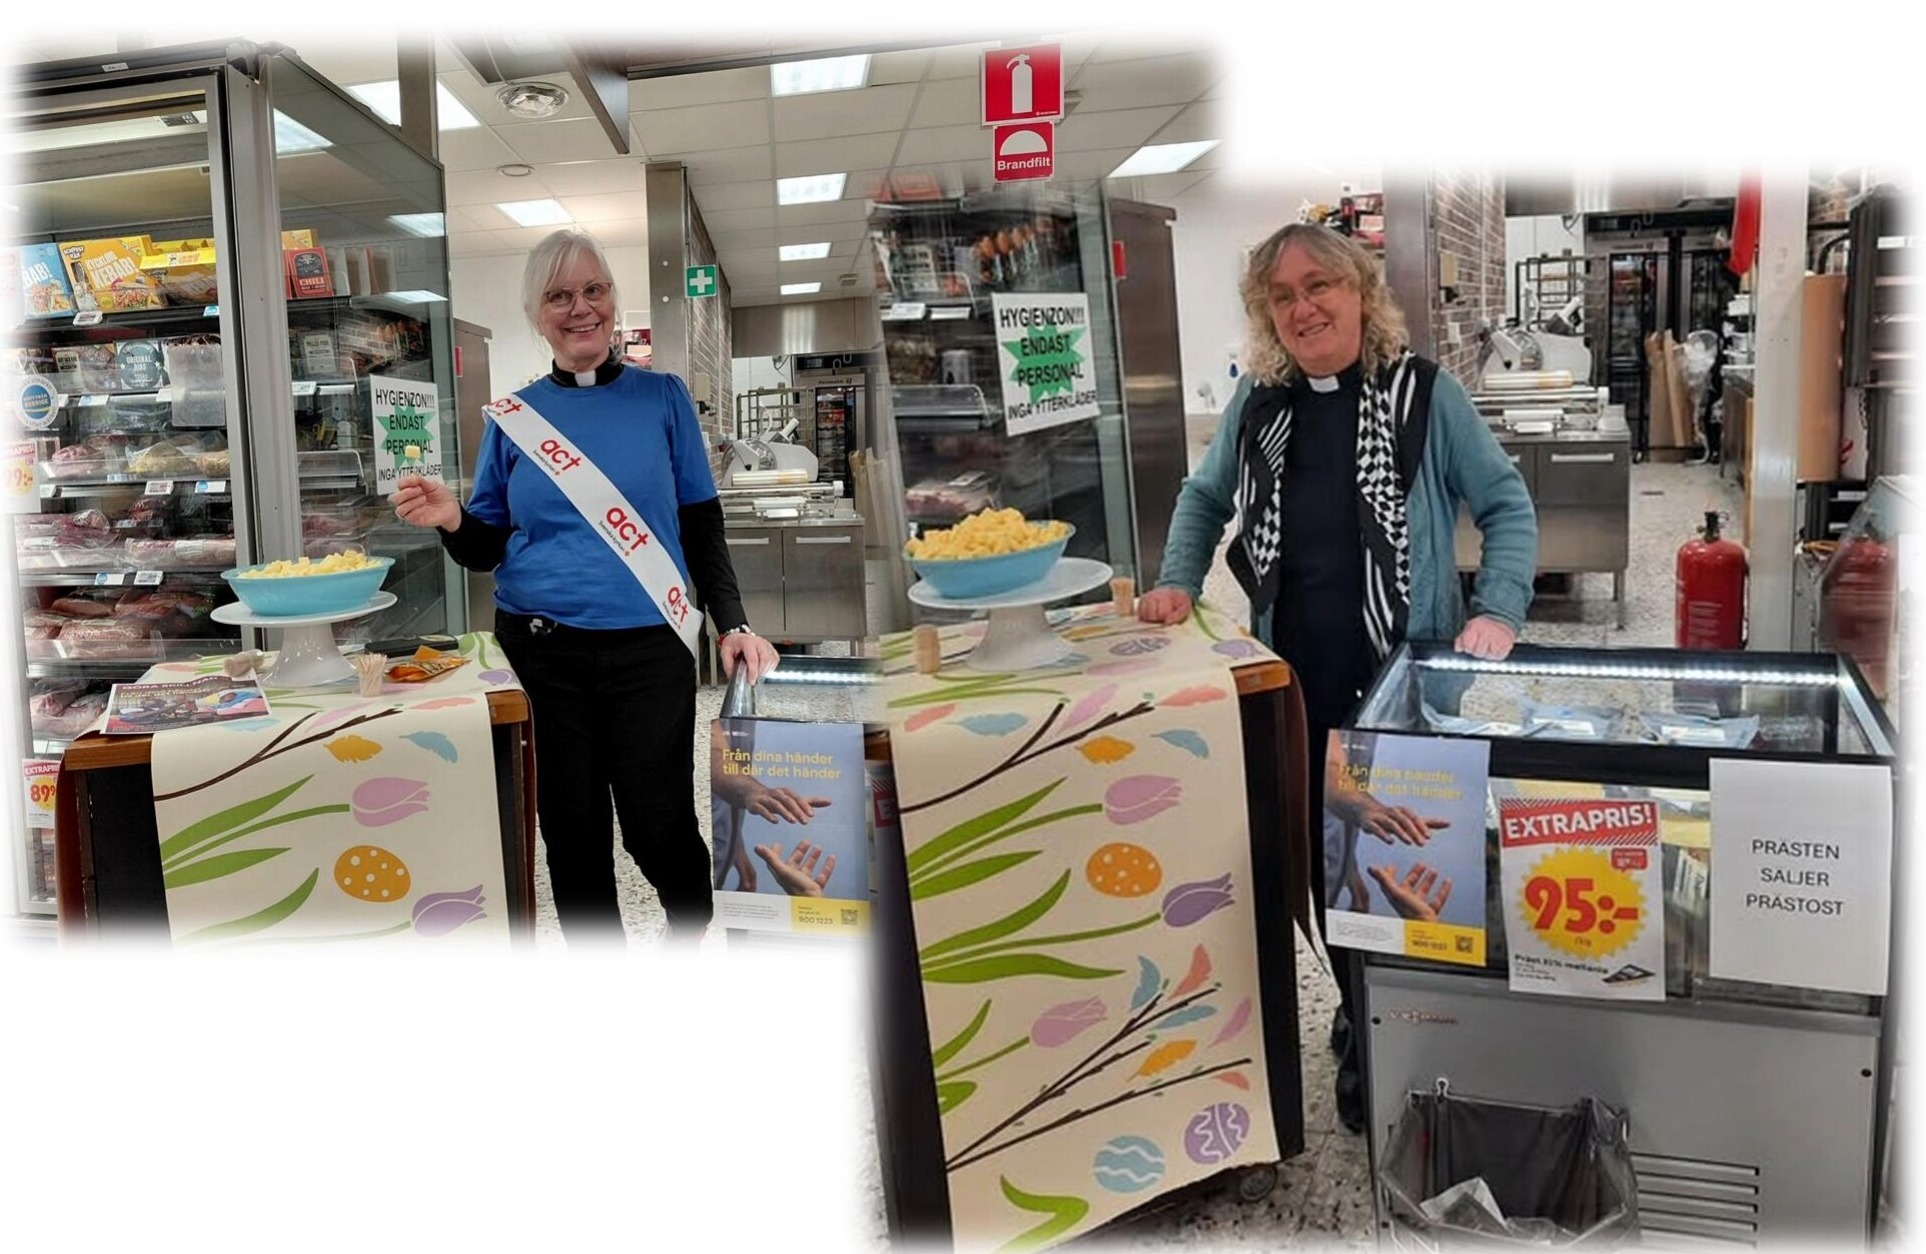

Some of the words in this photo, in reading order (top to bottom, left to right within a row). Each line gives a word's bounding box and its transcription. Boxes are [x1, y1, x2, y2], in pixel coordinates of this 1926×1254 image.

[997, 157, 1051, 170] Brandfilt
[90, 256, 139, 289] KEBAB!
[299, 277, 325, 286] CHILI
[1020, 334, 1071, 357] ENDAST
[1016, 362, 1084, 388] PERSONAL
[488, 398, 522, 414] ct
[1008, 402, 1033, 420] INGA
[389, 414, 424, 431] ENDAST
[540, 439, 582, 471] act
[378, 468, 396, 482] INGA
[606, 507, 649, 551] act
[722, 748, 751, 761] Från
[753, 750, 783, 763] dina
[786, 751, 834, 765] händer
[723, 763, 739, 775] till
[767, 766, 790, 778] det
[793, 766, 842, 780] händer
[1505, 804, 1653, 839] EXTRAPRIS!
[1752, 838, 1840, 860] PRÄSTEN
[1524, 876, 1640, 934] 95:-
[1746, 892, 1844, 916] PRÄSTOST
